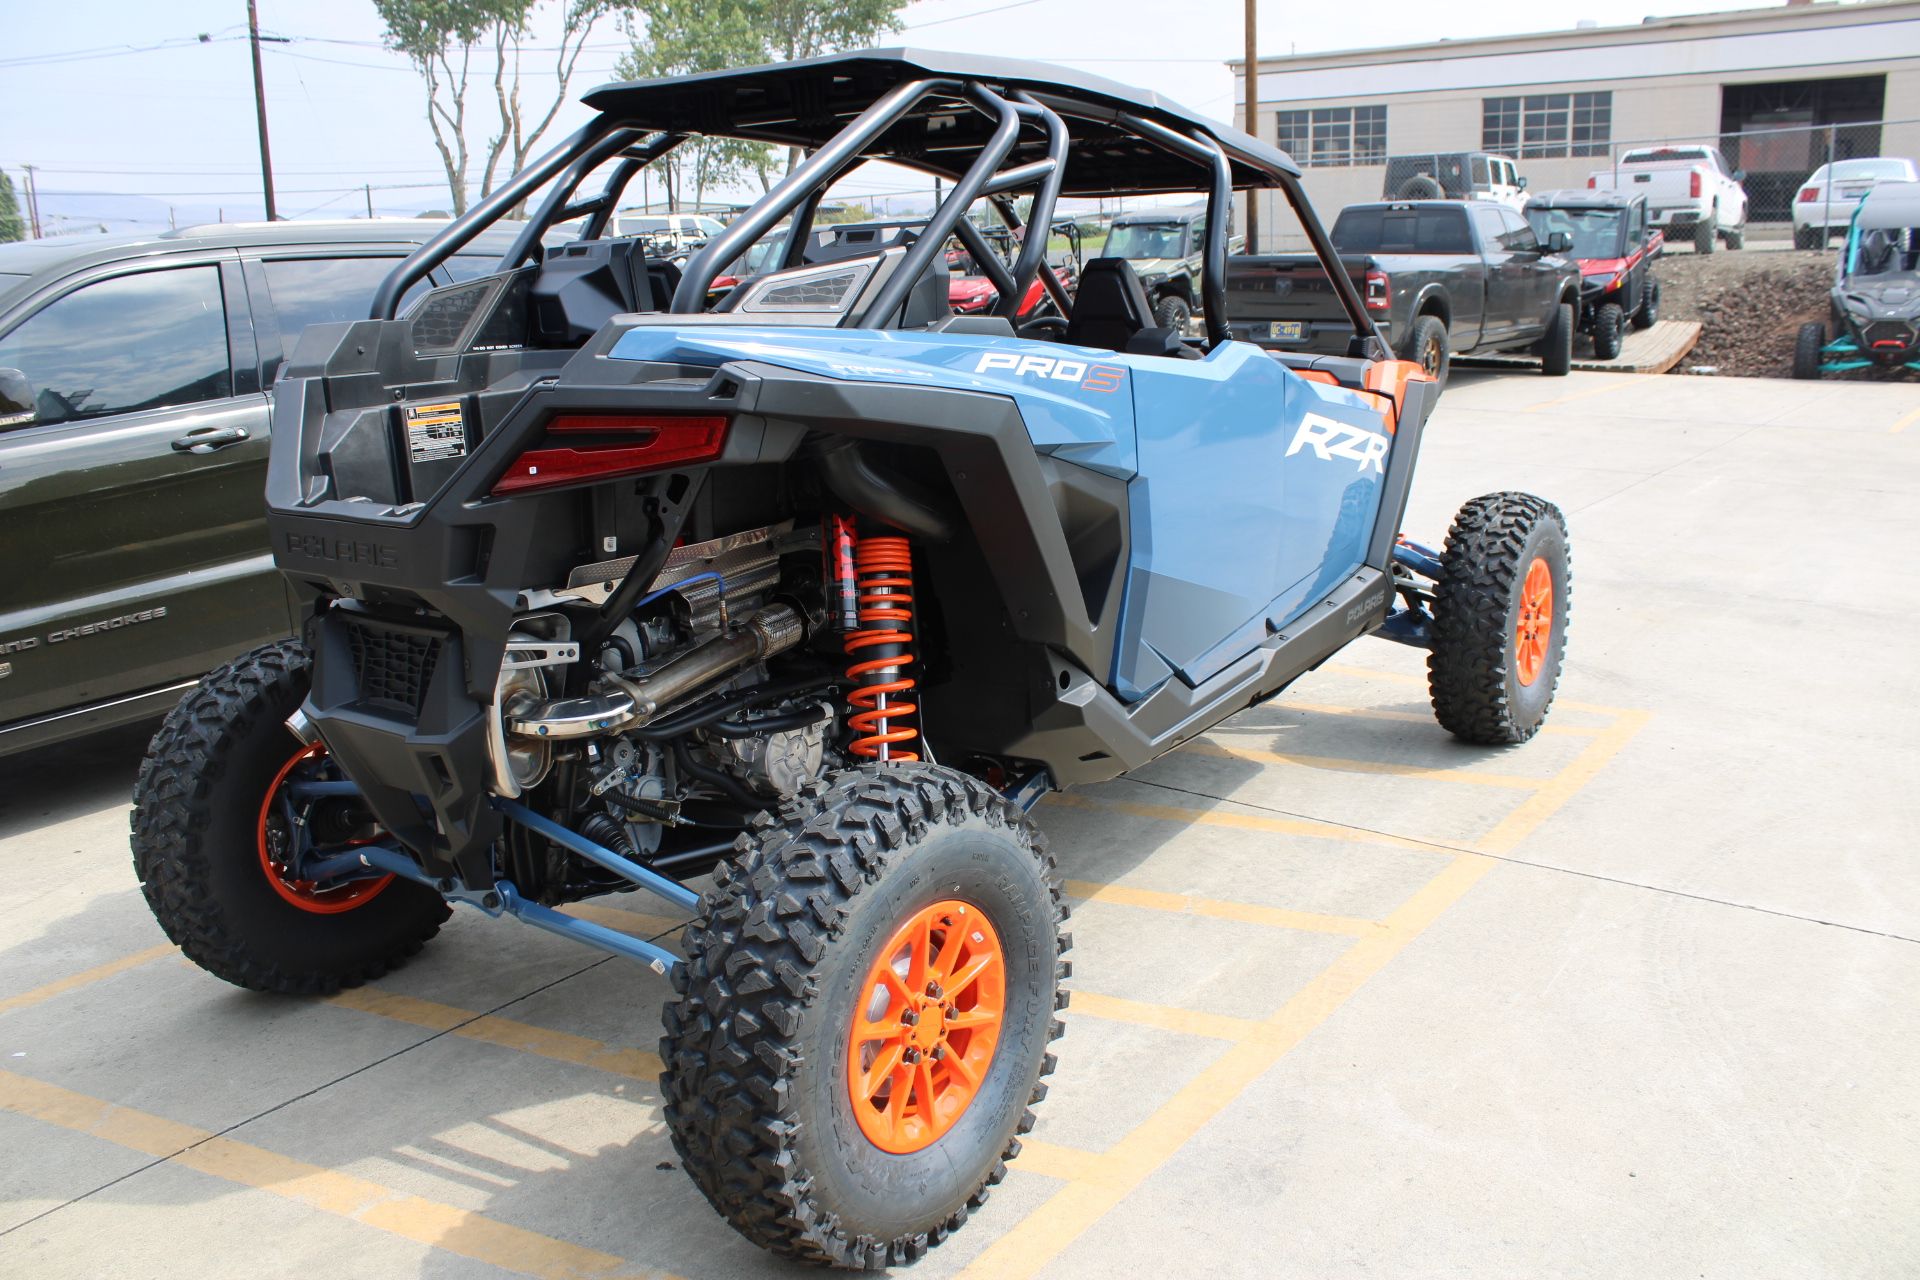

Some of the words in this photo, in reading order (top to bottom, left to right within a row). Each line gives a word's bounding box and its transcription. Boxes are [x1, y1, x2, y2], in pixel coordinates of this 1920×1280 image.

[974, 352, 1087, 382] PRO
[1081, 364, 1127, 393] S
[1284, 411, 1389, 474] RZR
[286, 532, 399, 570] POLARIS
[833, 513, 859, 582] FOX
[48, 606, 167, 644] CHEROKEE
[1346, 589, 1385, 625] POLARIS
